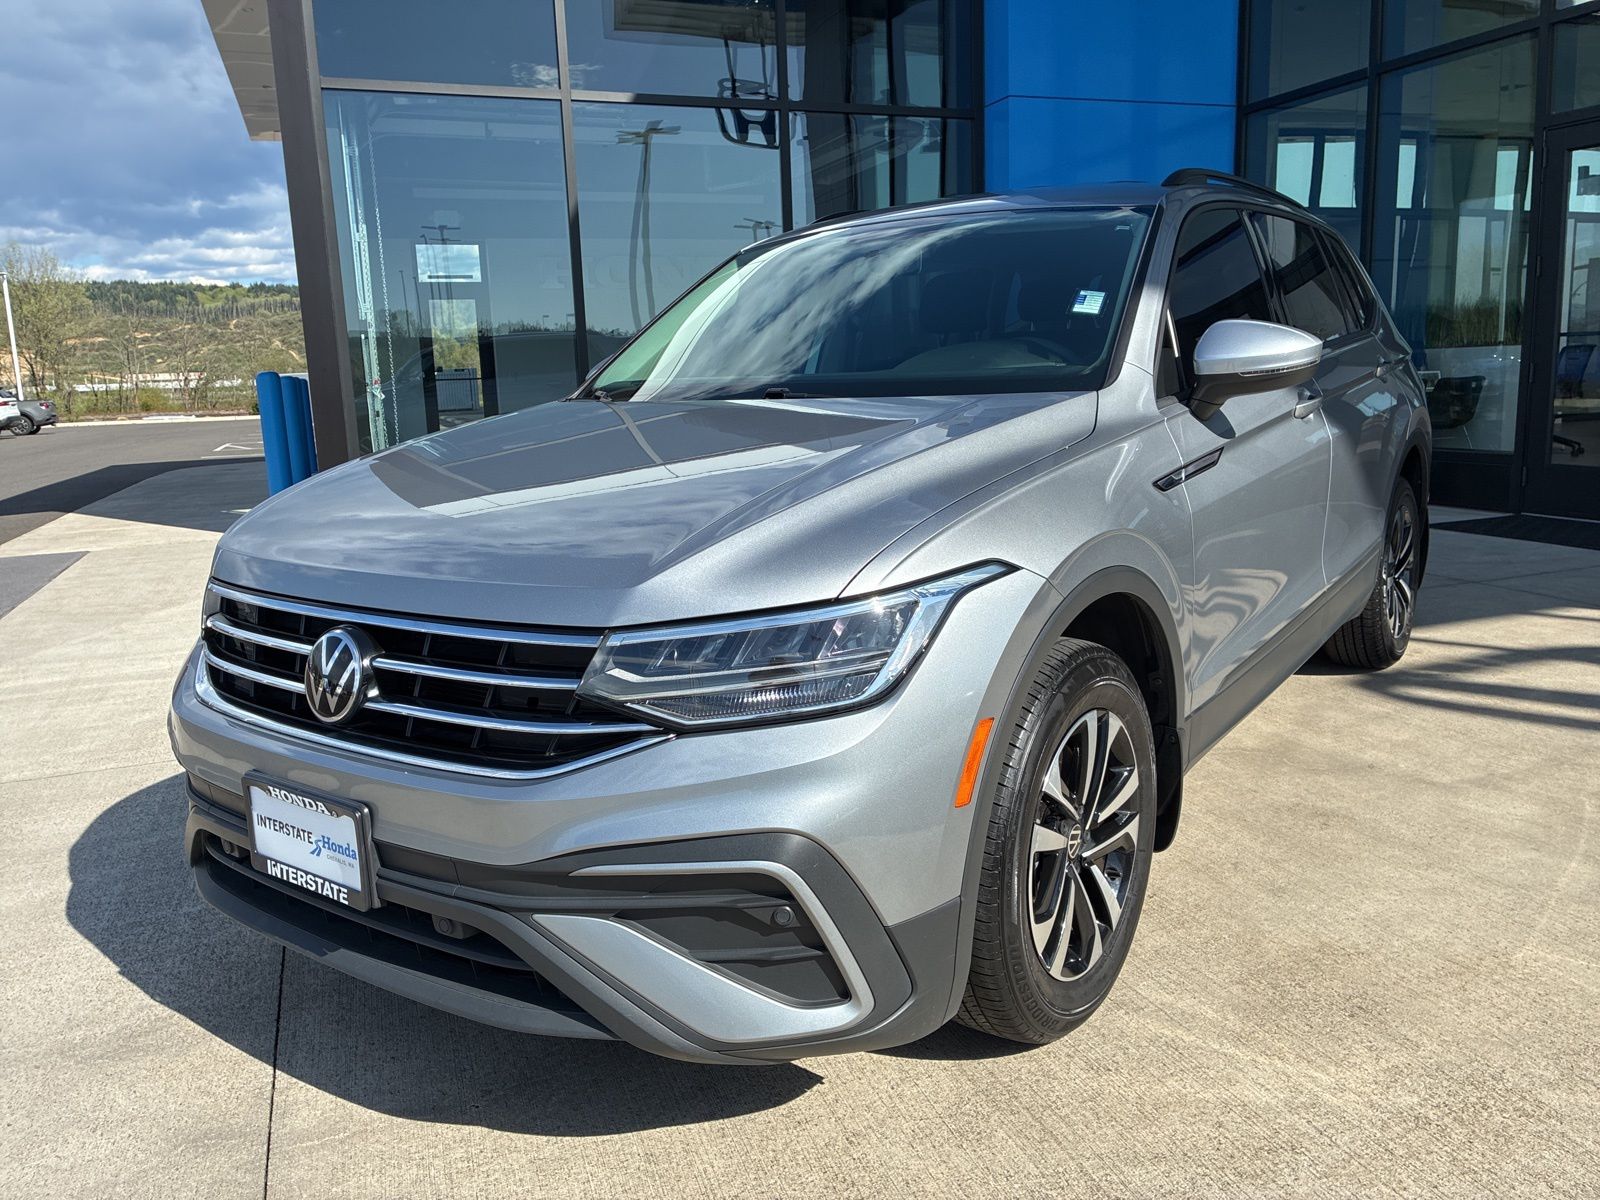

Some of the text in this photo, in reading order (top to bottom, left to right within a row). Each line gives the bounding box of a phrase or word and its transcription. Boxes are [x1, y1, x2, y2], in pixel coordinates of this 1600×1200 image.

[267, 785, 331, 816] HONDA
[256, 813, 357, 861] INTERSTATE Honda
[267, 859, 349, 905] INTERSTATE
